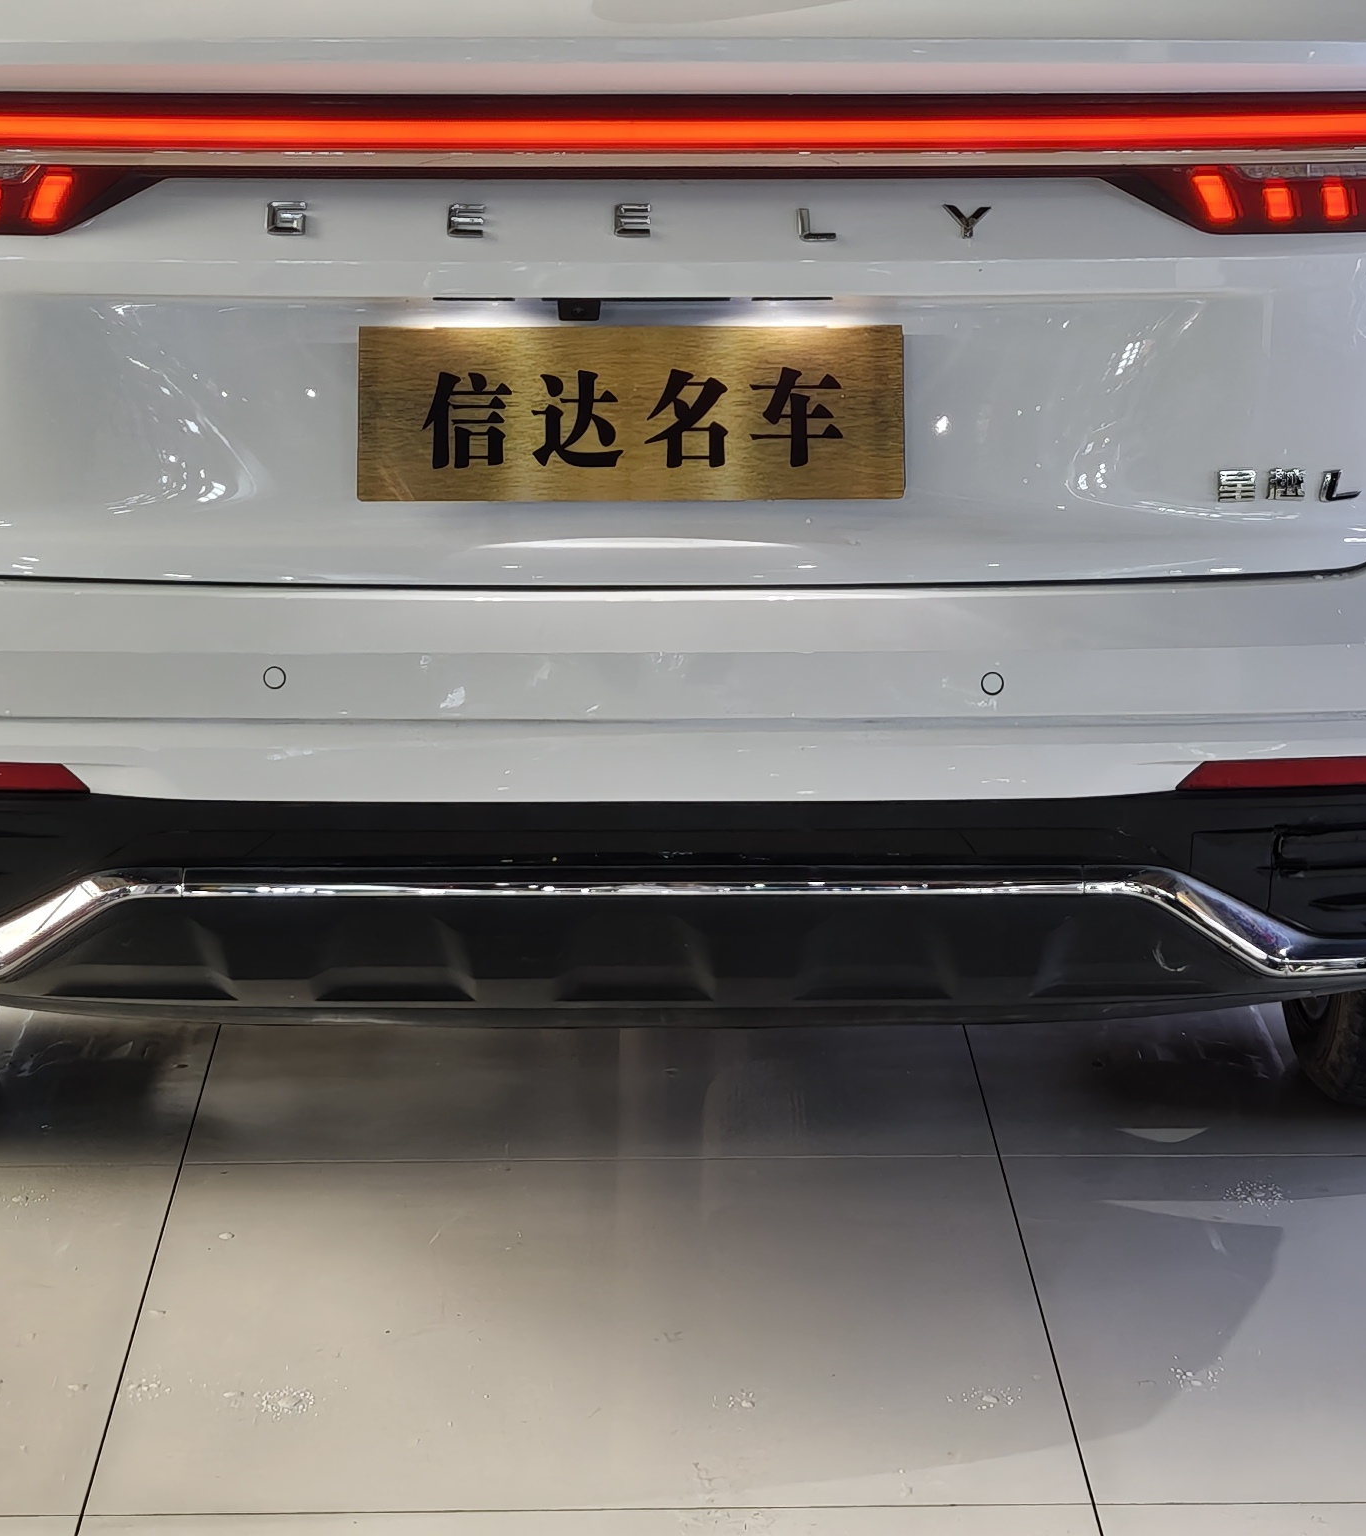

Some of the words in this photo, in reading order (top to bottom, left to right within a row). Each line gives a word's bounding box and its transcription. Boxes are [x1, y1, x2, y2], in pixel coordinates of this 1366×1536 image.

[265, 200, 992, 241] GEELY
[421, 367, 845, 472] 信达名车
[1217, 467, 1308, 503] 星越
[1319, 468, 1363, 503] L
